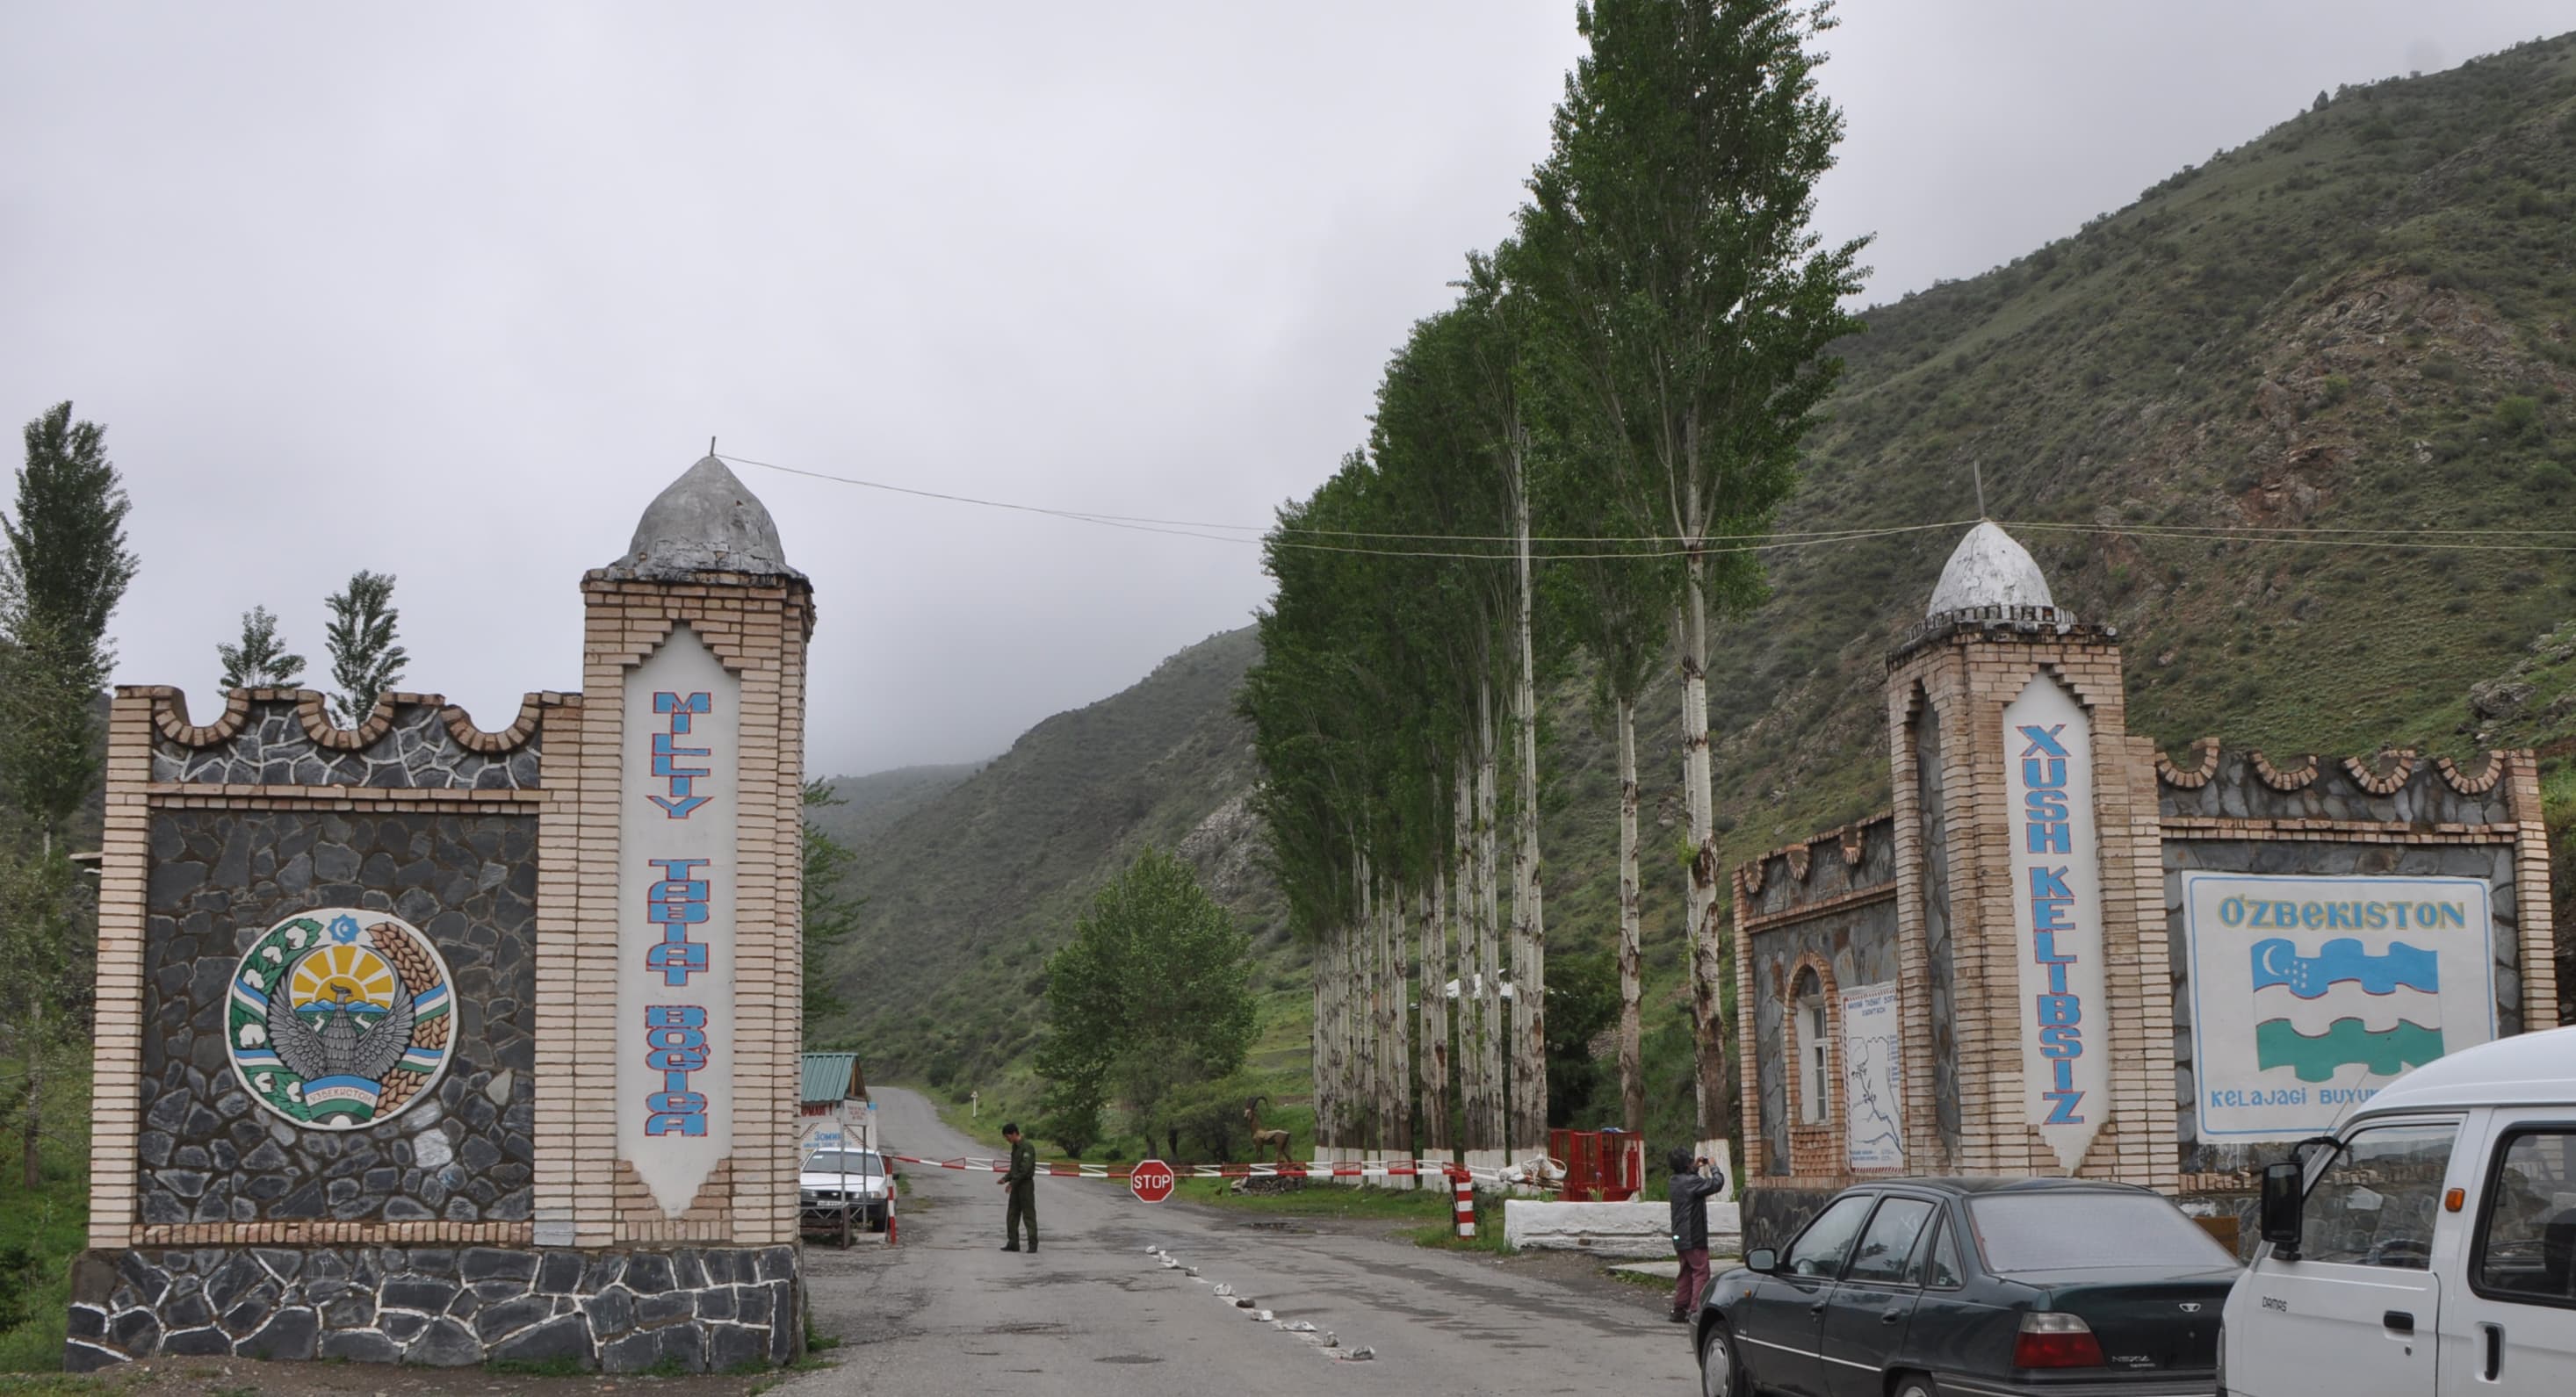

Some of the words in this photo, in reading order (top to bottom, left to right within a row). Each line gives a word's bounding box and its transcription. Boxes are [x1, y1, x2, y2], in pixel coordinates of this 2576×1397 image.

[646, 691, 715, 819] MILLIY
[2016, 724, 2073, 854] XUSH
[646, 859, 711, 987] TABIAT
[2029, 865, 2085, 1126] KELIBSIZ
[1134, 1174, 1171, 1189] STOP
[2262, 1296, 2287, 1313] DAMAS
